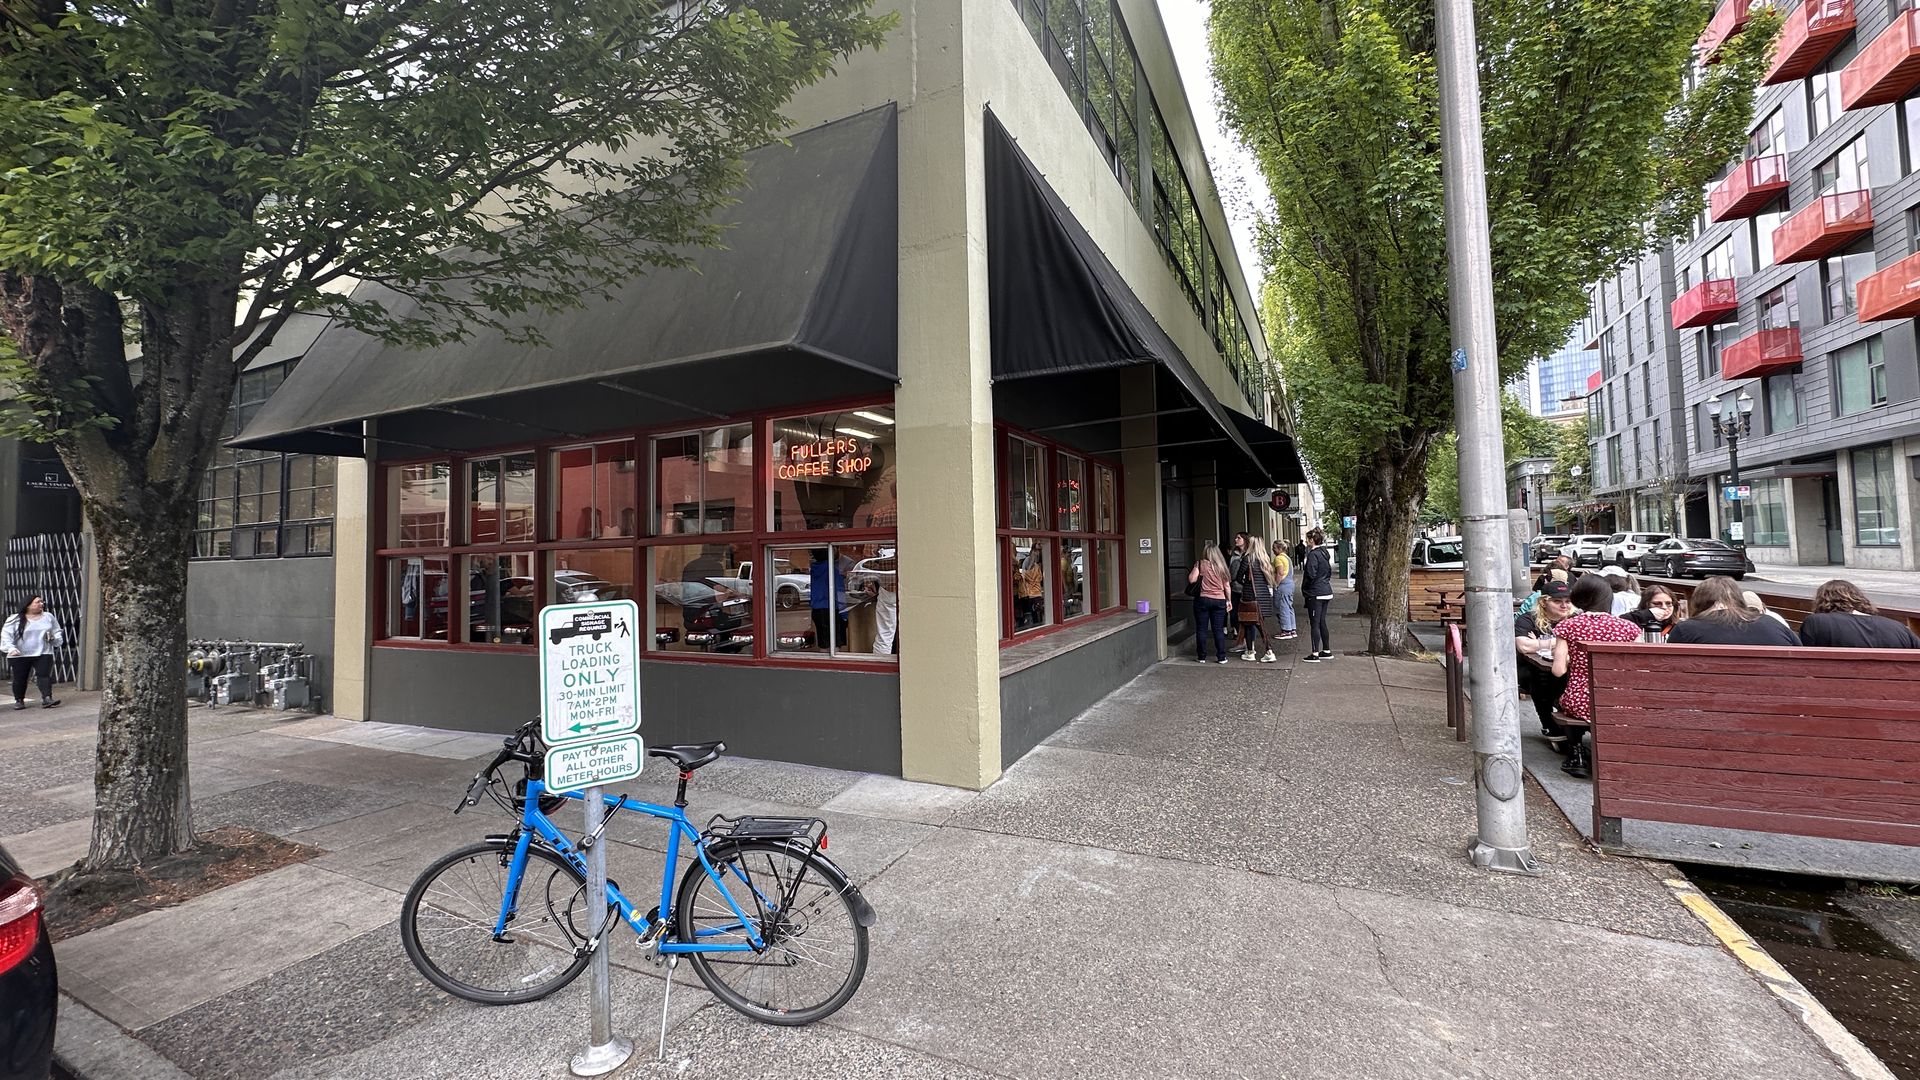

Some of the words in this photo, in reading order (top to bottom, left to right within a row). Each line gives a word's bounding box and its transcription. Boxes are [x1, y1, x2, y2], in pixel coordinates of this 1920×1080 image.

[779, 460, 830, 479] COFFEE
[836, 457, 872, 474] SHOP
[568, 642, 613, 657] TRUCK
[561, 654, 620, 671] LOADING
[563, 668, 620, 688] ONLY
[559, 689, 597, 701] 30-MIN
[599, 684, 625, 696] LIMIT
[567, 696, 617, 711] 7AM-2PM
[570, 707, 615, 722] MON-FRI
[562, 751, 582, 763] PAY
[584, 747, 597, 757] TO
[600, 743, 628, 756] PARK
[566, 761, 587, 773] ALL
[589, 754, 625, 768] OTHER
[557, 770, 593, 785] METER
[596, 763, 633, 777] HOURS
[552, 833, 587, 877] TRE
